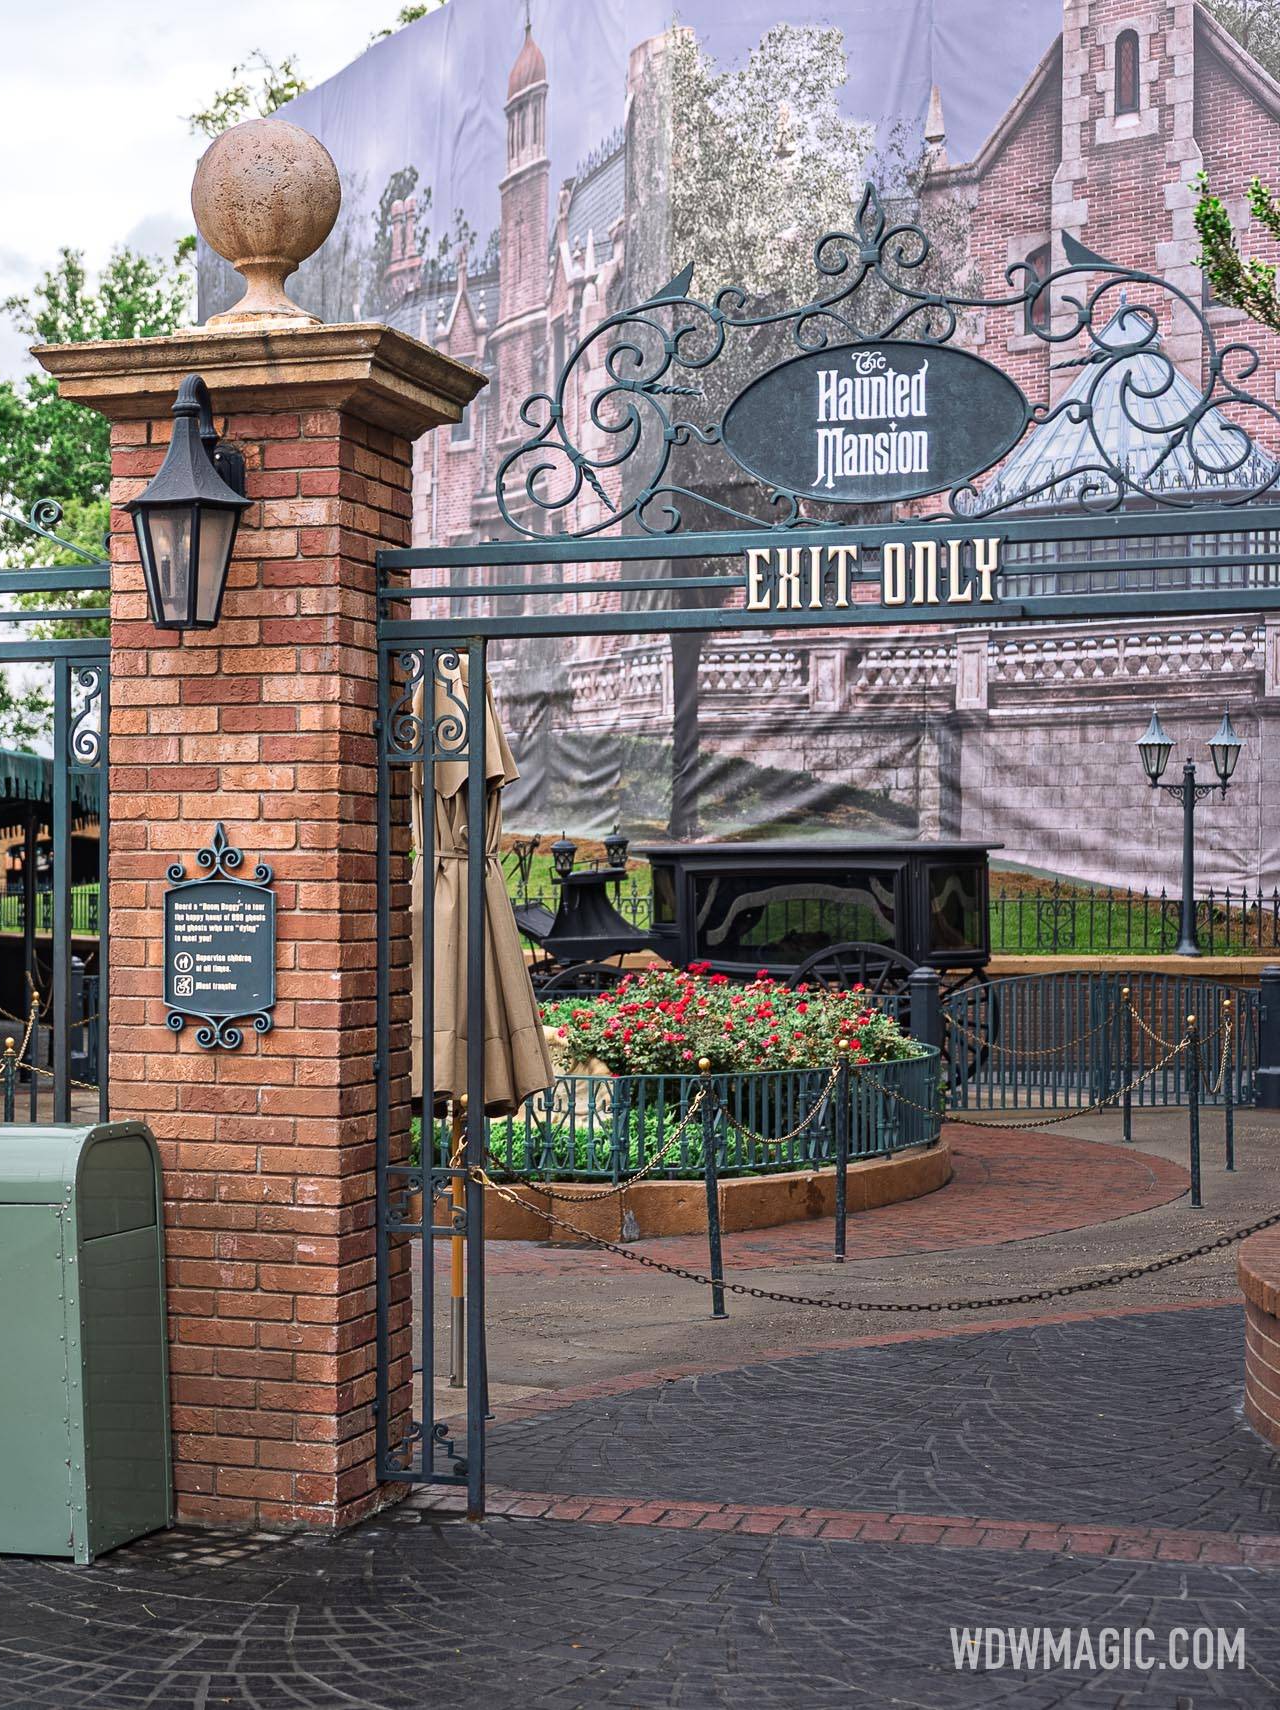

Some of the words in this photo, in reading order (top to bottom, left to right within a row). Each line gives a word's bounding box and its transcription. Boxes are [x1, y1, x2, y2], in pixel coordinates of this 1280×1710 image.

[817, 359, 928, 422] Haunted
[851, 351, 886, 374] The
[811, 422, 928, 489] Mansion
[746, 545, 858, 610] EXIT
[883, 538, 1001, 605] ONLY
